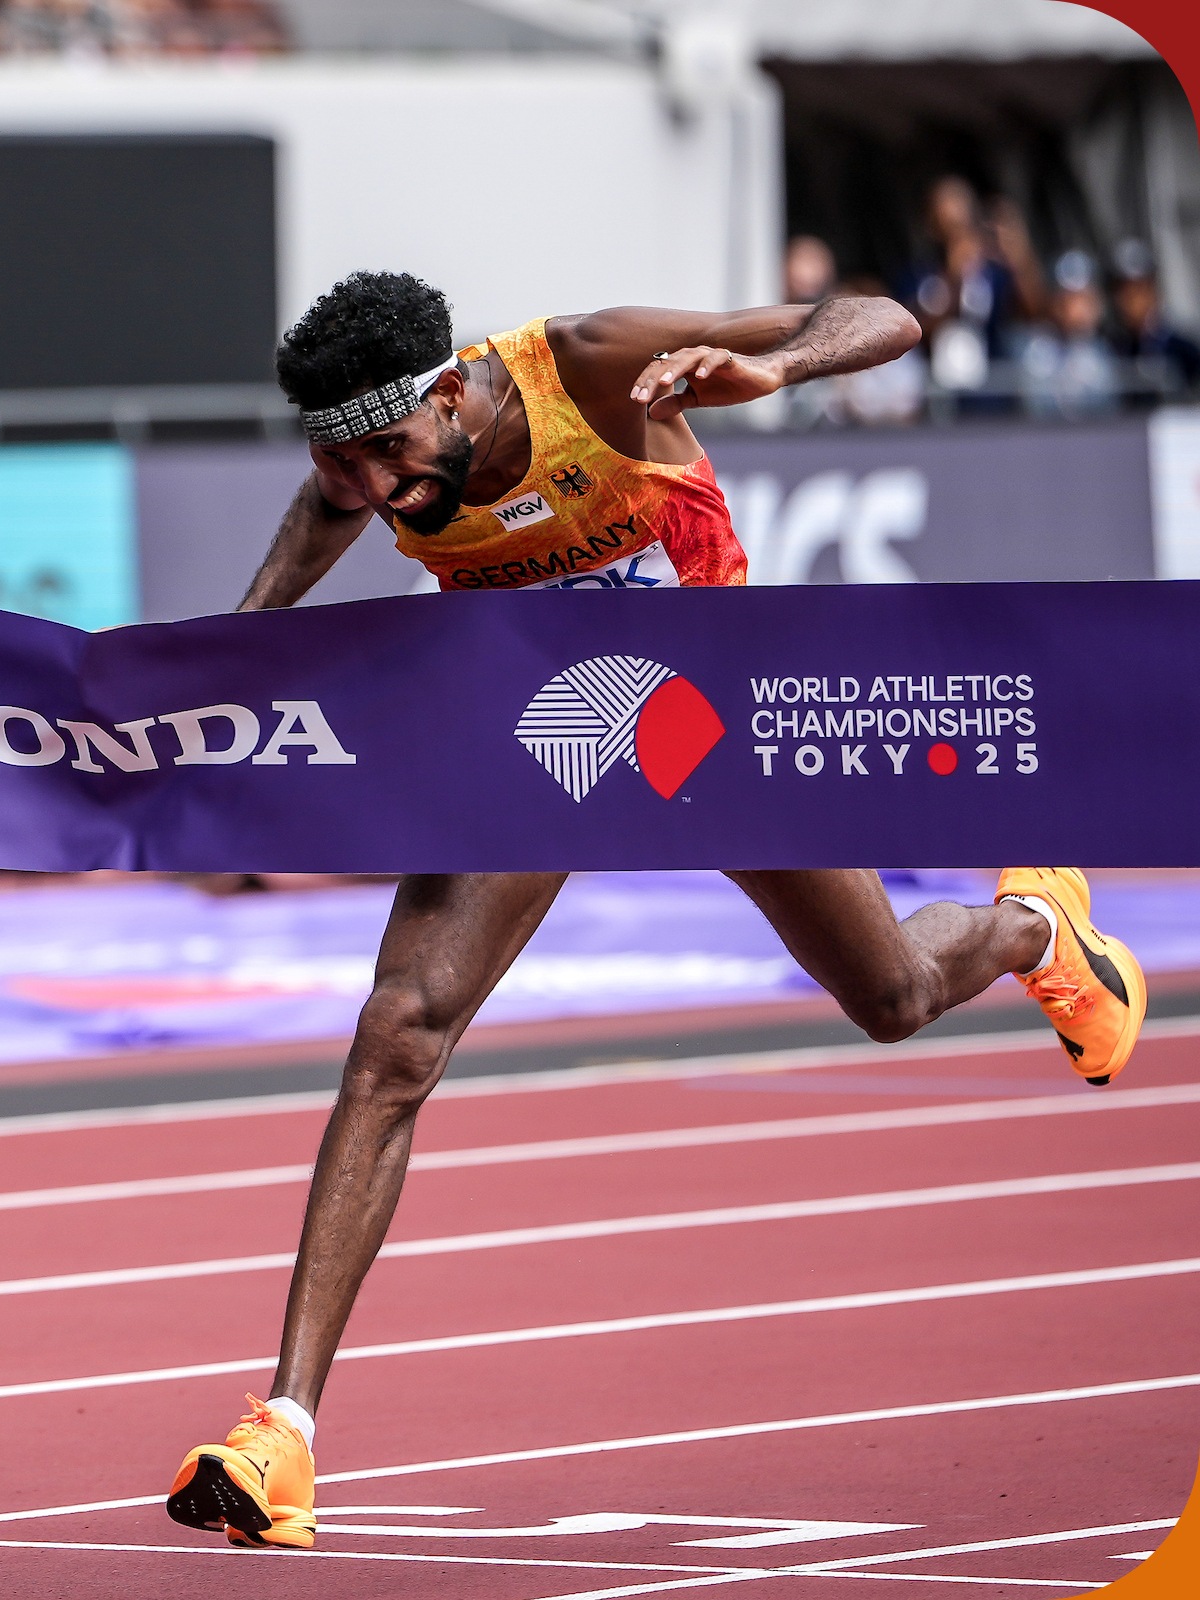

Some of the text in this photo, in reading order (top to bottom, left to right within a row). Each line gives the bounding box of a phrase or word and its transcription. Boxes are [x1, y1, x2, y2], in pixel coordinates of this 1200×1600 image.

[495, 496, 543, 522] WGV
[452, 514, 637, 589] GERMANY
[750, 675, 1034, 703] WORLD ATHLETICS
[751, 708, 1036, 739] CHAMPIONSHIPS
